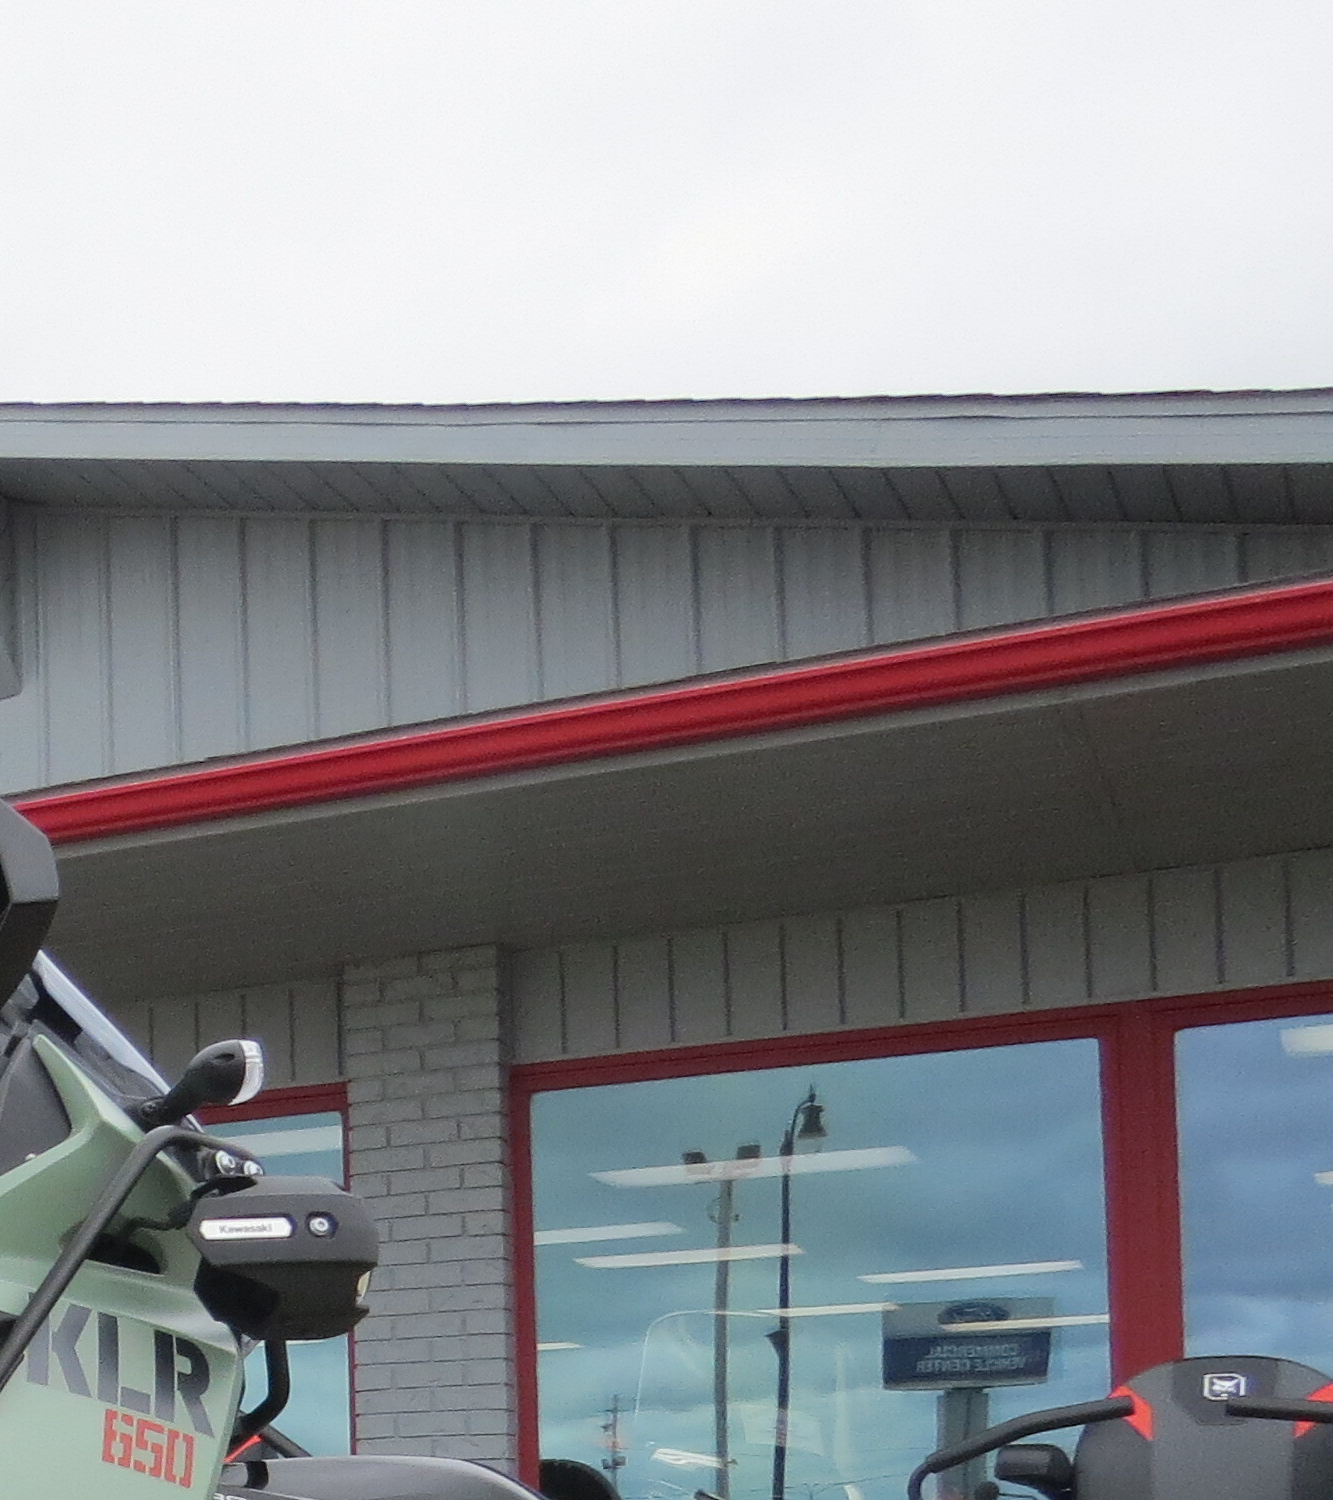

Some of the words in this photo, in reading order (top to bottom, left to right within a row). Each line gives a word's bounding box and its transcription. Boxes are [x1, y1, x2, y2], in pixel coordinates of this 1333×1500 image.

[219, 1223, 273, 1234] Kawasaki
[27, 1291, 216, 1438] KLR
[101, 1408, 195, 1488] 650
